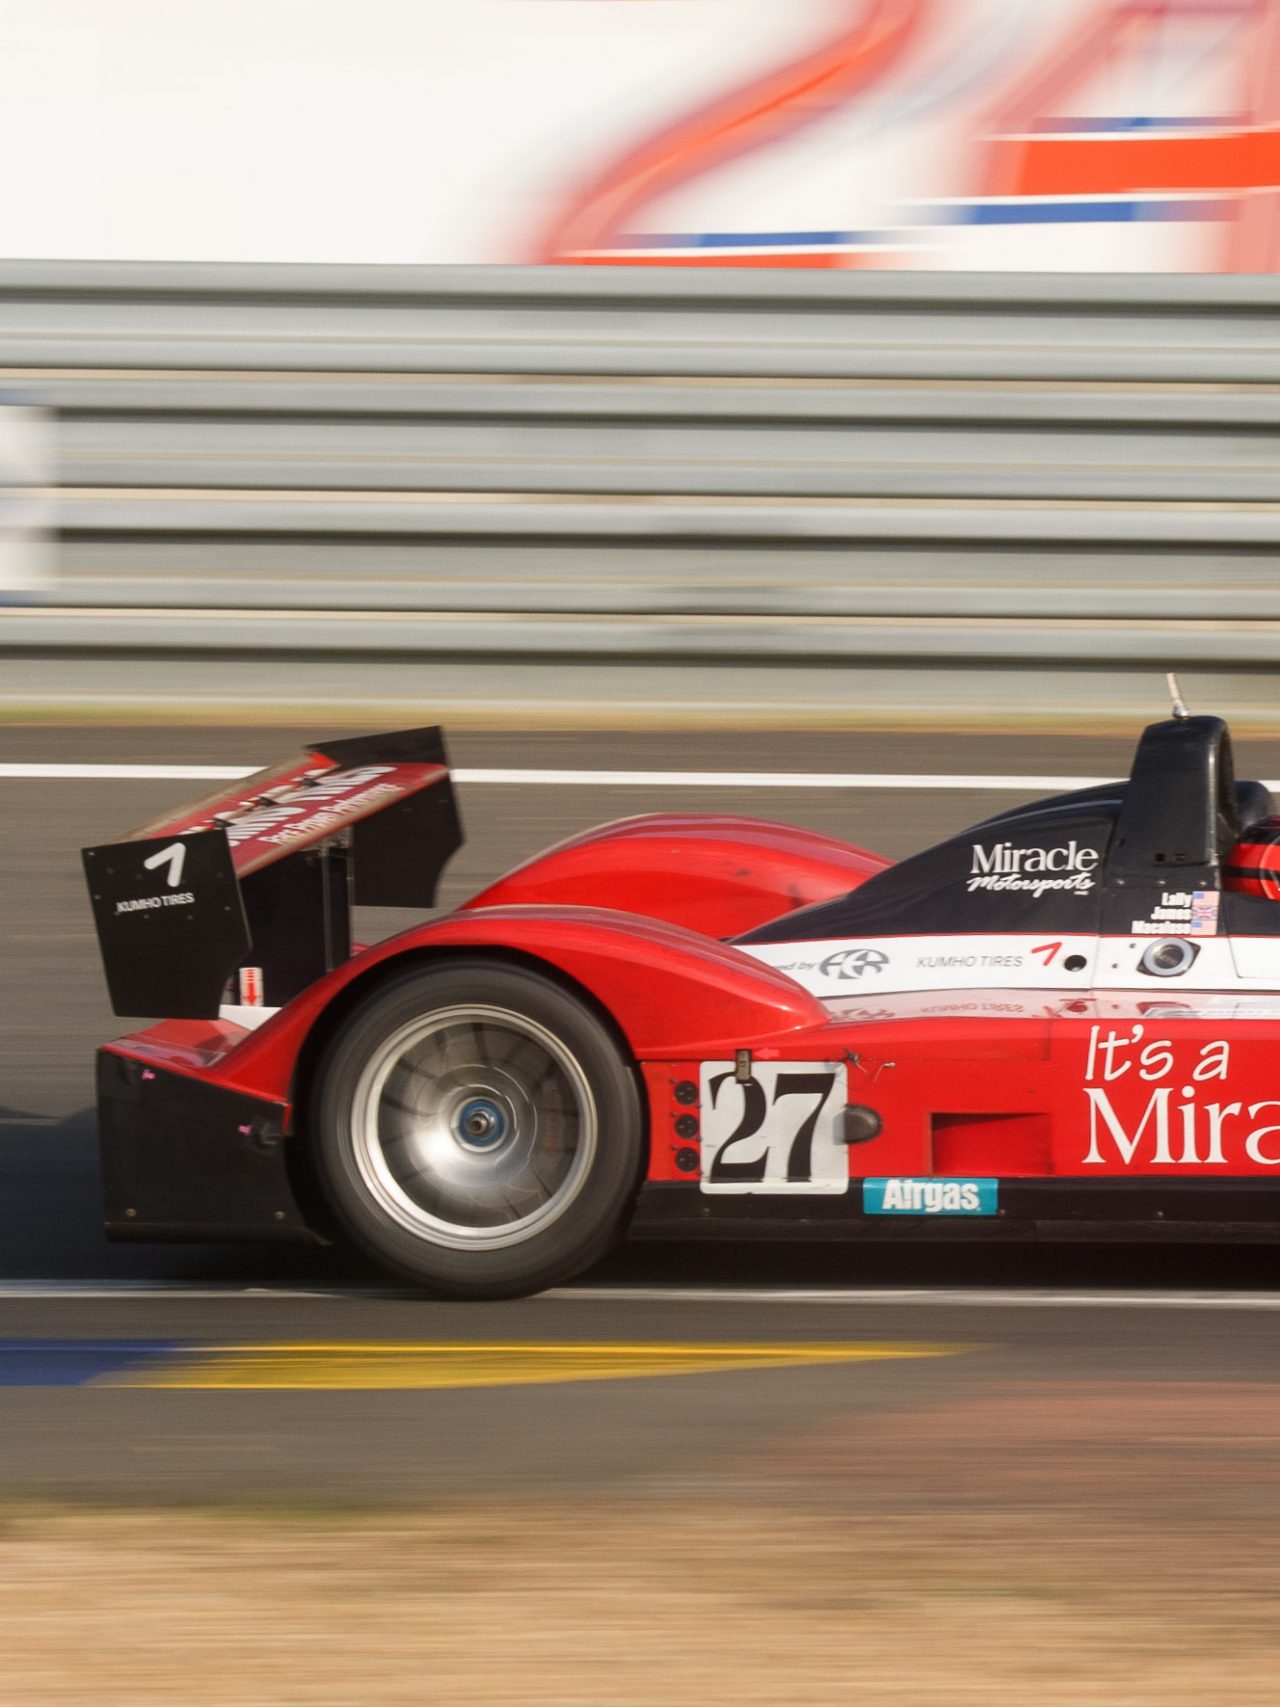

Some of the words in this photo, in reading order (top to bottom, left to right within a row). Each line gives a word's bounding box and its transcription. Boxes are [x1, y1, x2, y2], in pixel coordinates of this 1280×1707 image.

[970, 840, 1099, 874] Miracle
[116, 897, 161, 912] KUMHO
[161, 892, 195, 906] TIRES
[967, 872, 1096, 898] Motorsports
[915, 956, 976, 969] KUMHO
[979, 955, 1024, 968] TIRES
[1085, 1024, 1175, 1082] It's
[1193, 1039, 1231, 1082] a
[708, 1071, 837, 1184] 27
[882, 1179, 980, 1213] Airgas
